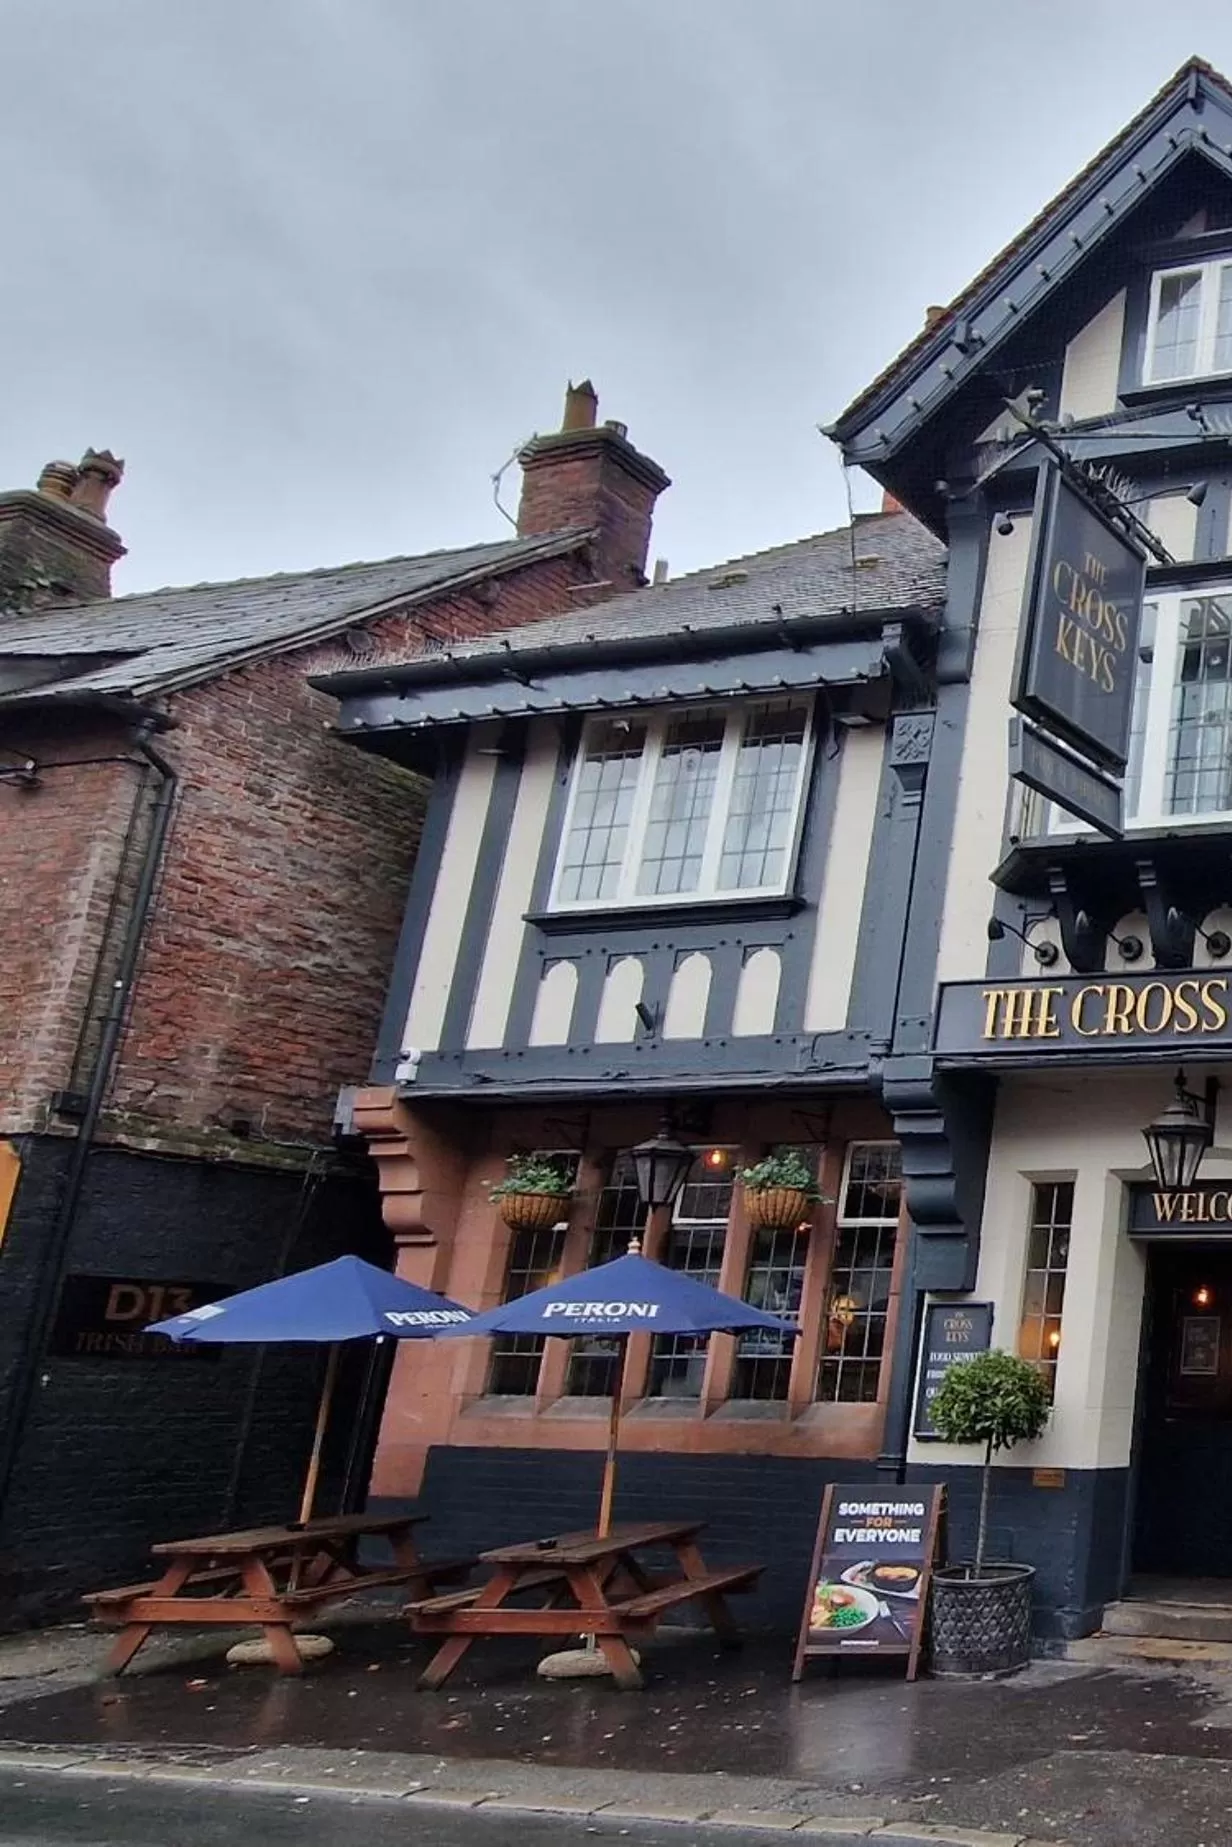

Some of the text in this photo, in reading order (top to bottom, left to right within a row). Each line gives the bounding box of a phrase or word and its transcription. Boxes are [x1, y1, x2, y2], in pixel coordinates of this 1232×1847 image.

[1085, 552, 1107, 585] THE
[1054, 560, 1128, 652] CROSS
[1056, 611, 1116, 693] KEYS
[981, 986, 1065, 1039] THE
[1070, 978, 1227, 1036] CROSS
[104, 1283, 193, 1321] D13
[543, 1302, 660, 1318] PERONI
[384, 1310, 472, 1326] PERONI
[838, 1503, 925, 1516] SOMETHING
[865, 1516, 893, 1528] FOR
[834, 1528, 922, 1543] EVERYONE
